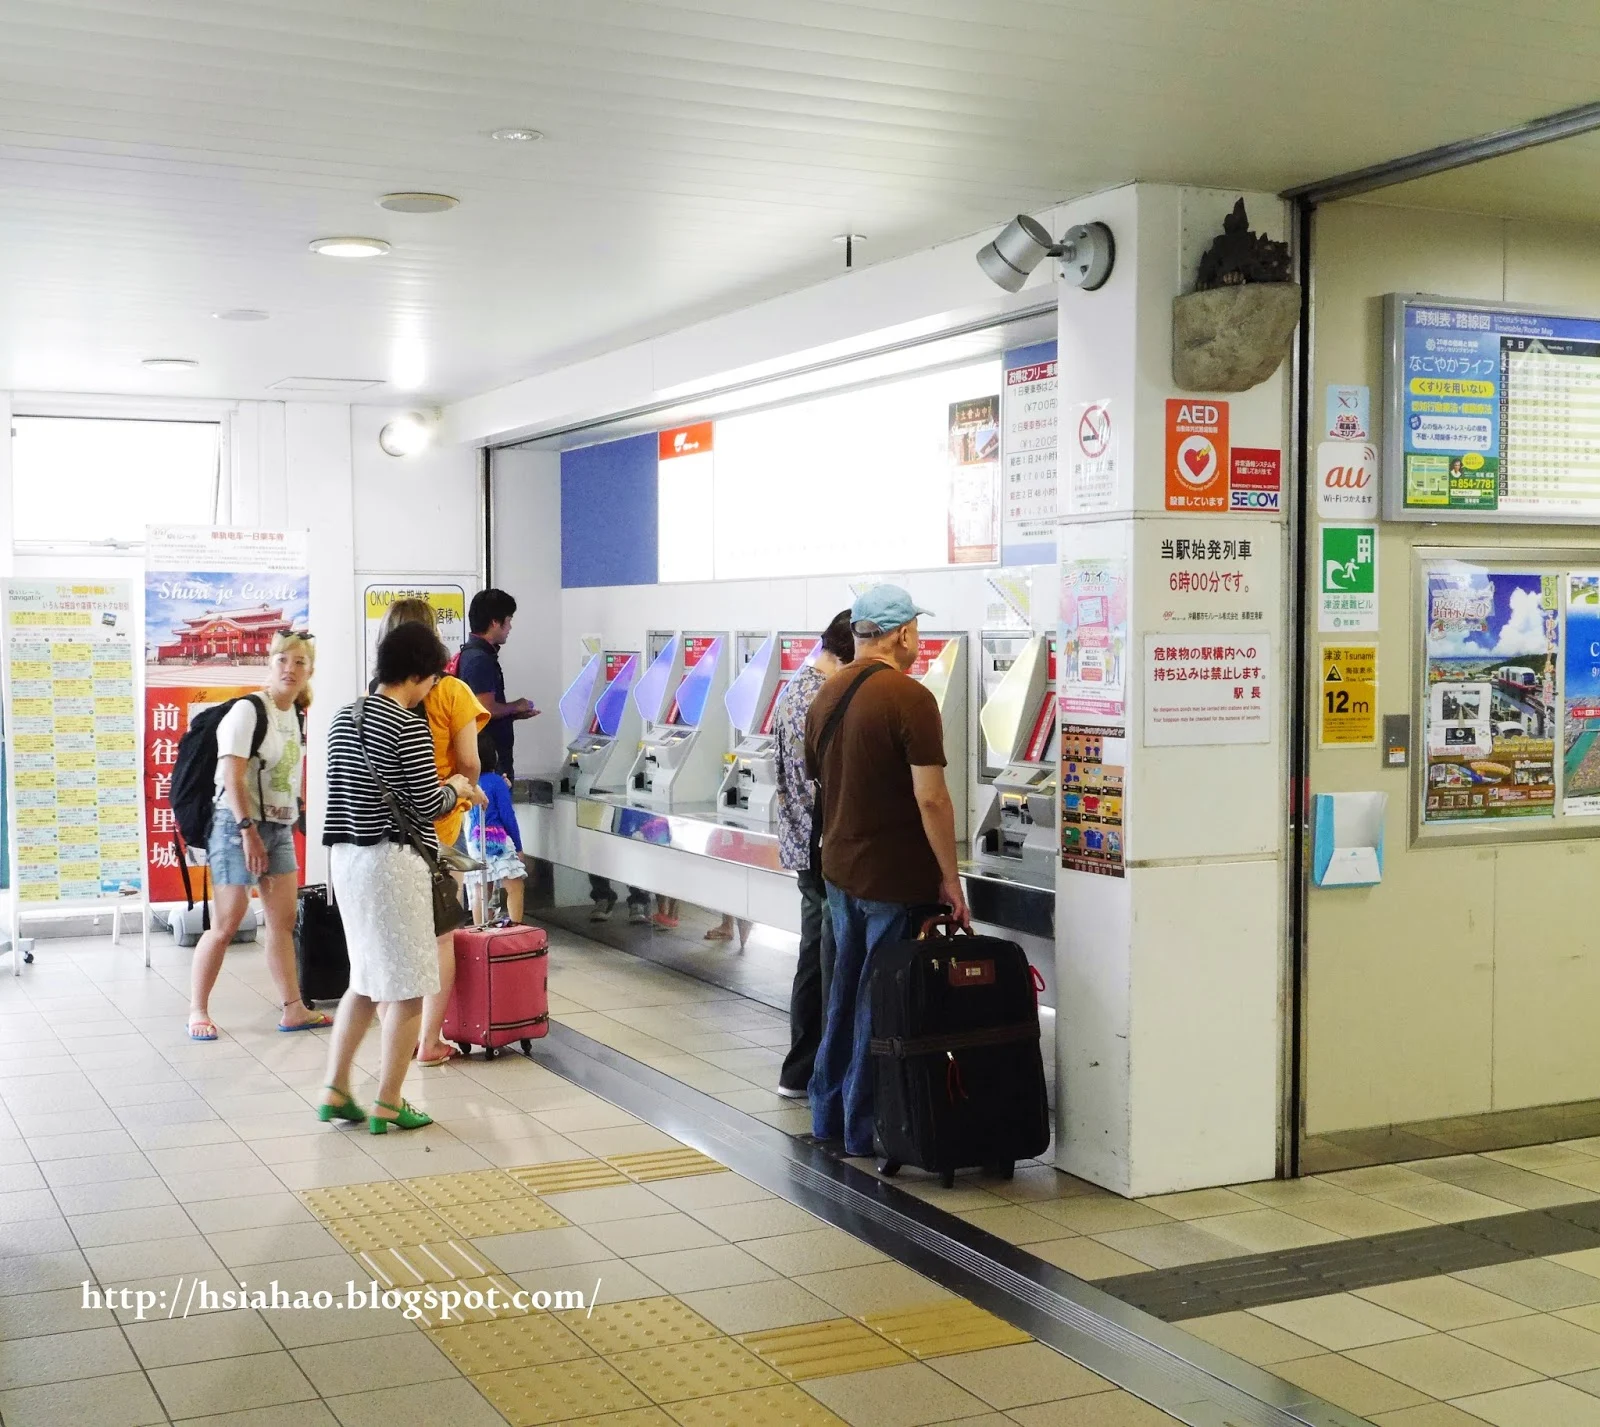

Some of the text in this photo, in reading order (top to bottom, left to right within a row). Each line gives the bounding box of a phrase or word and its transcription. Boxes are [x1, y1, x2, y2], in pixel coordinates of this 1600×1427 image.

[1409, 355, 1494, 374] なごやかライフ
[1418, 381, 1487, 394] くすりを用いない
[1177, 405, 1218, 424] AED
[1325, 466, 1371, 488] au
[1458, 479, 1494, 489] 854-7781
[1169, 496, 1224, 506] 設置しています
[1232, 491, 1278, 507] SECOM
[1161, 539, 1252, 560] 当駅始発列車
[1169, 570, 1249, 593] 6時00分です。
[241, 582, 297, 601] Castle
[1154, 647, 1256, 660] 危険物の駅構内への
[1324, 650, 1374, 660] 津波 Tsunami
[1154, 667, 1266, 681] 持ち込みは禁止します。
[1234, 687, 1261, 699] 駅長
[1326, 691, 1368, 713] 12 m
[150, 703, 180, 869] 前往首里城
